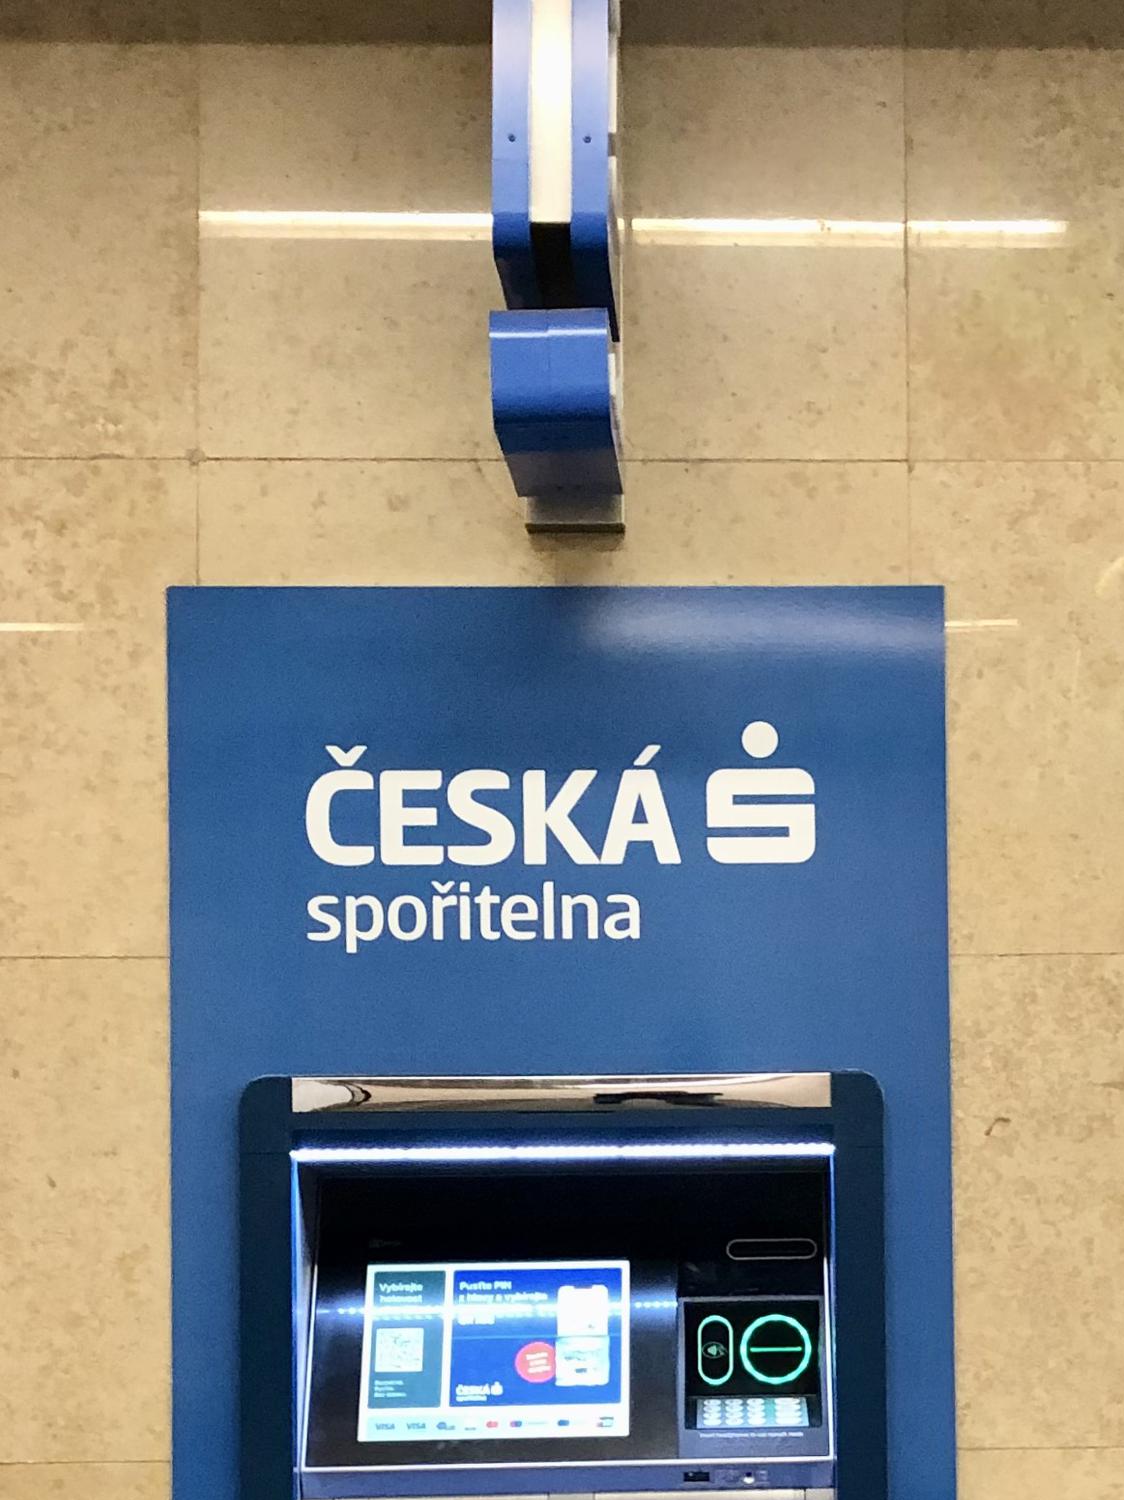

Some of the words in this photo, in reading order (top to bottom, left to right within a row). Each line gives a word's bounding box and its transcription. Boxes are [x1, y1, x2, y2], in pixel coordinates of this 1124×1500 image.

[305, 743, 683, 867] ČESKÁ
[306, 880, 642, 954] spořitelna
[374, 1422, 395, 1430] VISA
[406, 1422, 426, 1430] VISA
